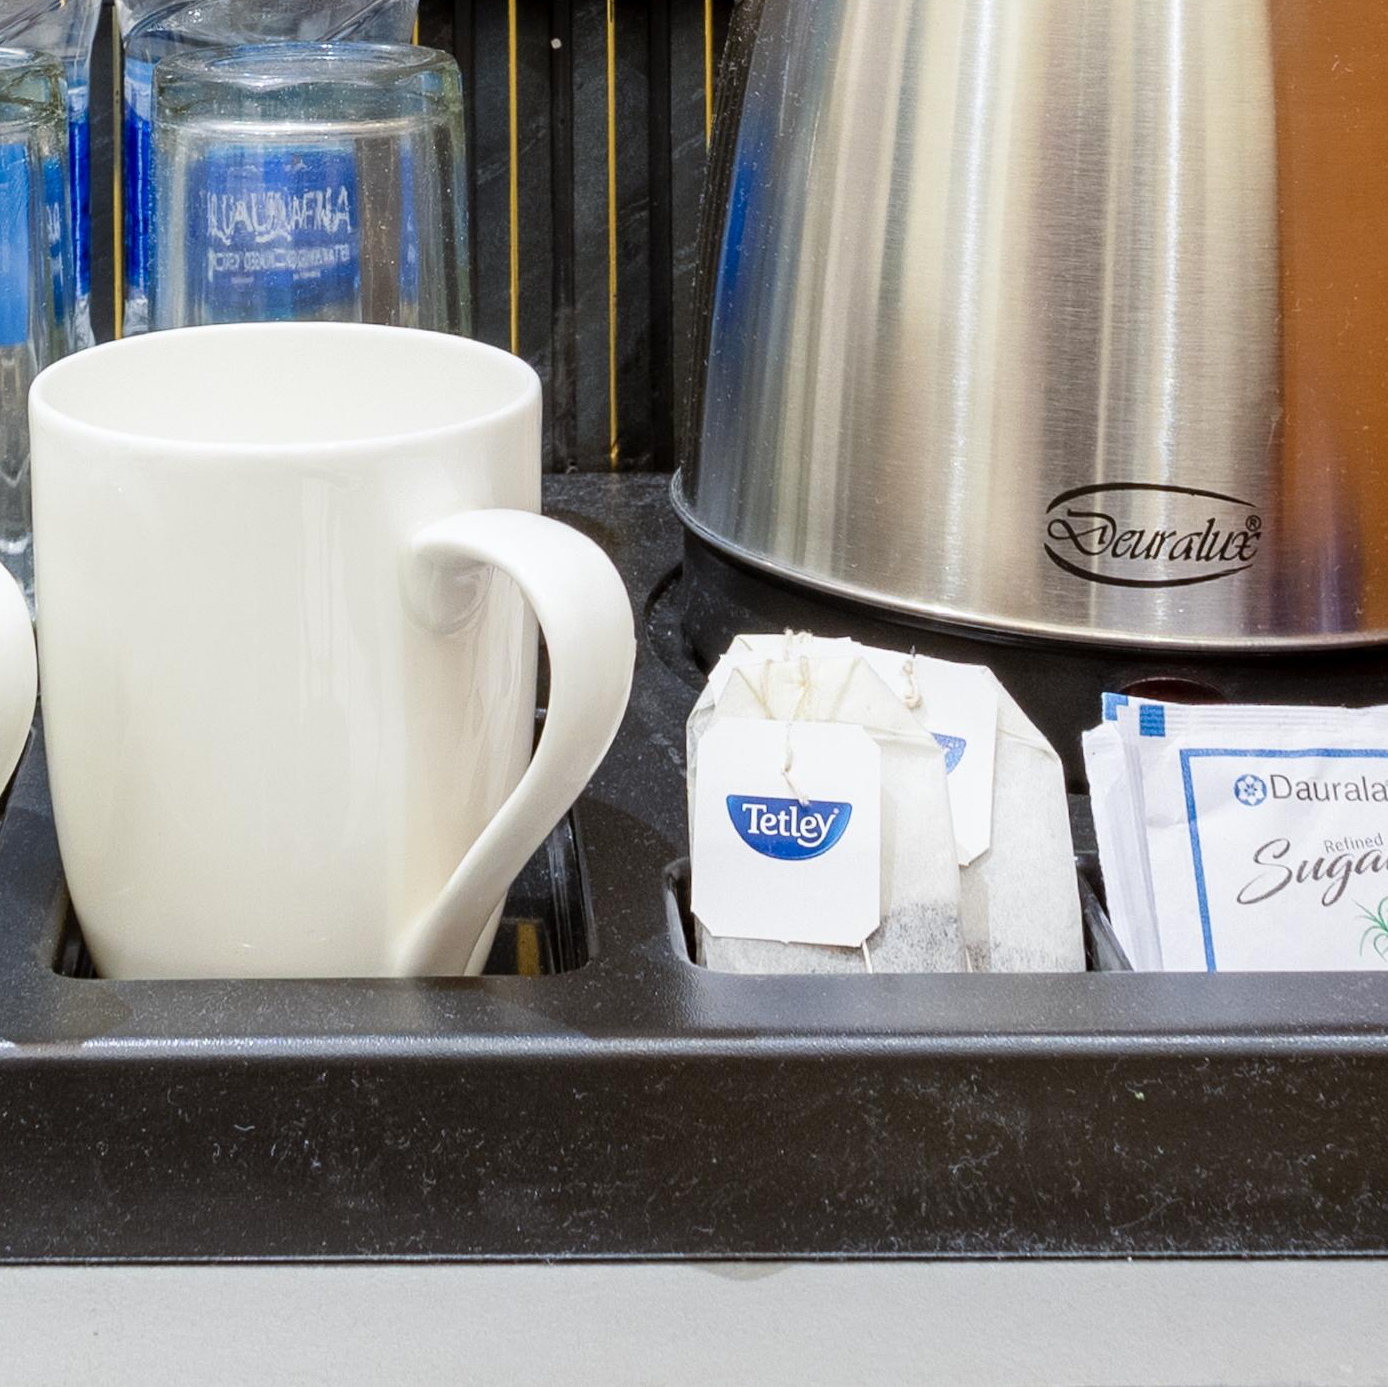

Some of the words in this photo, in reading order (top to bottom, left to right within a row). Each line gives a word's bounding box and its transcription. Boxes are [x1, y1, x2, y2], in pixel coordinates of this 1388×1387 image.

[1047, 509, 1261, 562] Deuralux
[742, 803, 836, 848] Tetley
[1324, 833, 1384, 854] Refined
